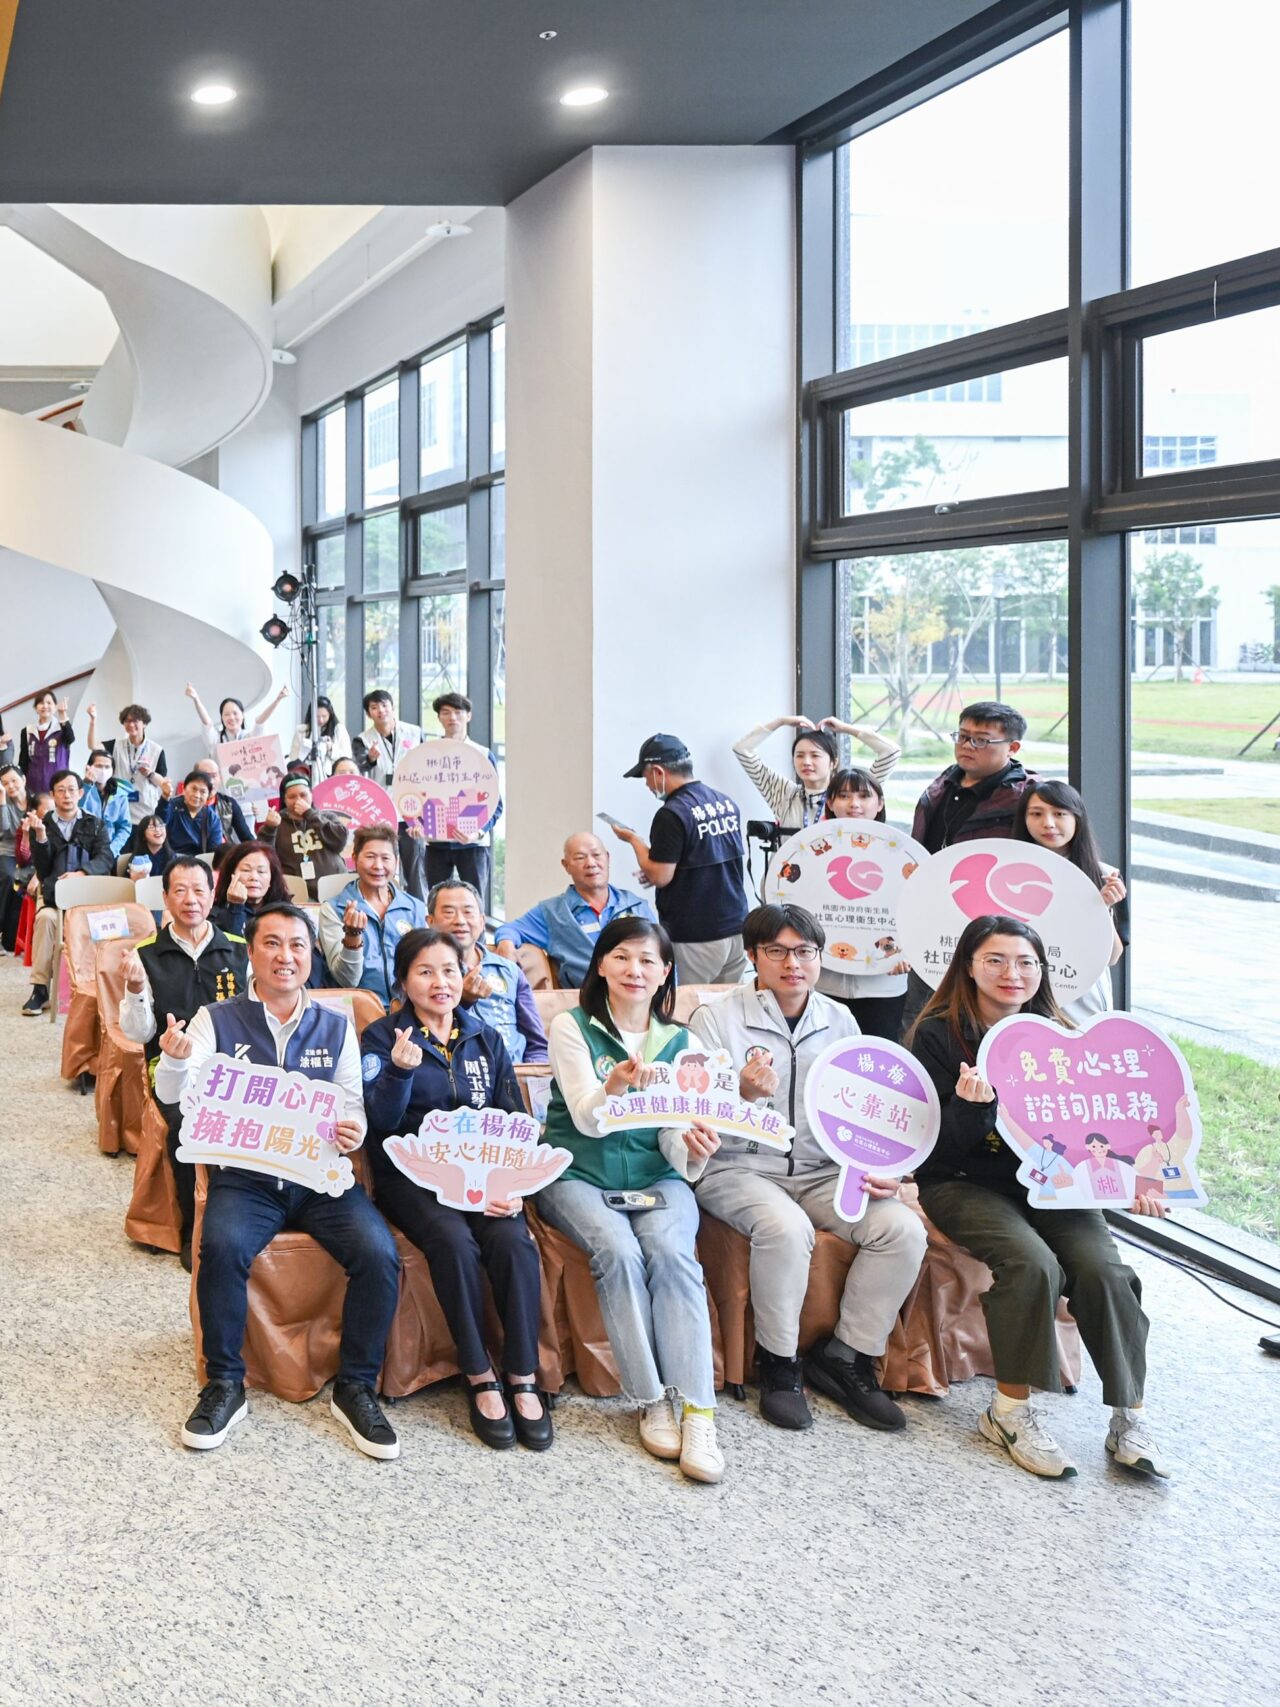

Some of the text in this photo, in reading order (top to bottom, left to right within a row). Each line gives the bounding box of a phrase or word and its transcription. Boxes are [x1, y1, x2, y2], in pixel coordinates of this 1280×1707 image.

[697, 815, 739, 840] POLICE
[814, 913, 896, 927] 社區心理衛生中心
[822, 904, 889, 915] 桃園市政府衛生局
[300, 1055, 333, 1068] 涂權吉
[1019, 1048, 1148, 1085] 免費心理
[203, 1063, 336, 1118] 打開心門
[464, 1060, 487, 1109] 周玉琴
[608, 1095, 782, 1136] 心理健康推廣大使
[833, 1086, 912, 1133] 心靠站
[1023, 1091, 1158, 1124] 諮詢服務
[189, 1106, 321, 1161] 擁抱陽光
[424, 1111, 535, 1143] 心在楊梅
[429, 1141, 527, 1171] 安心相隨
